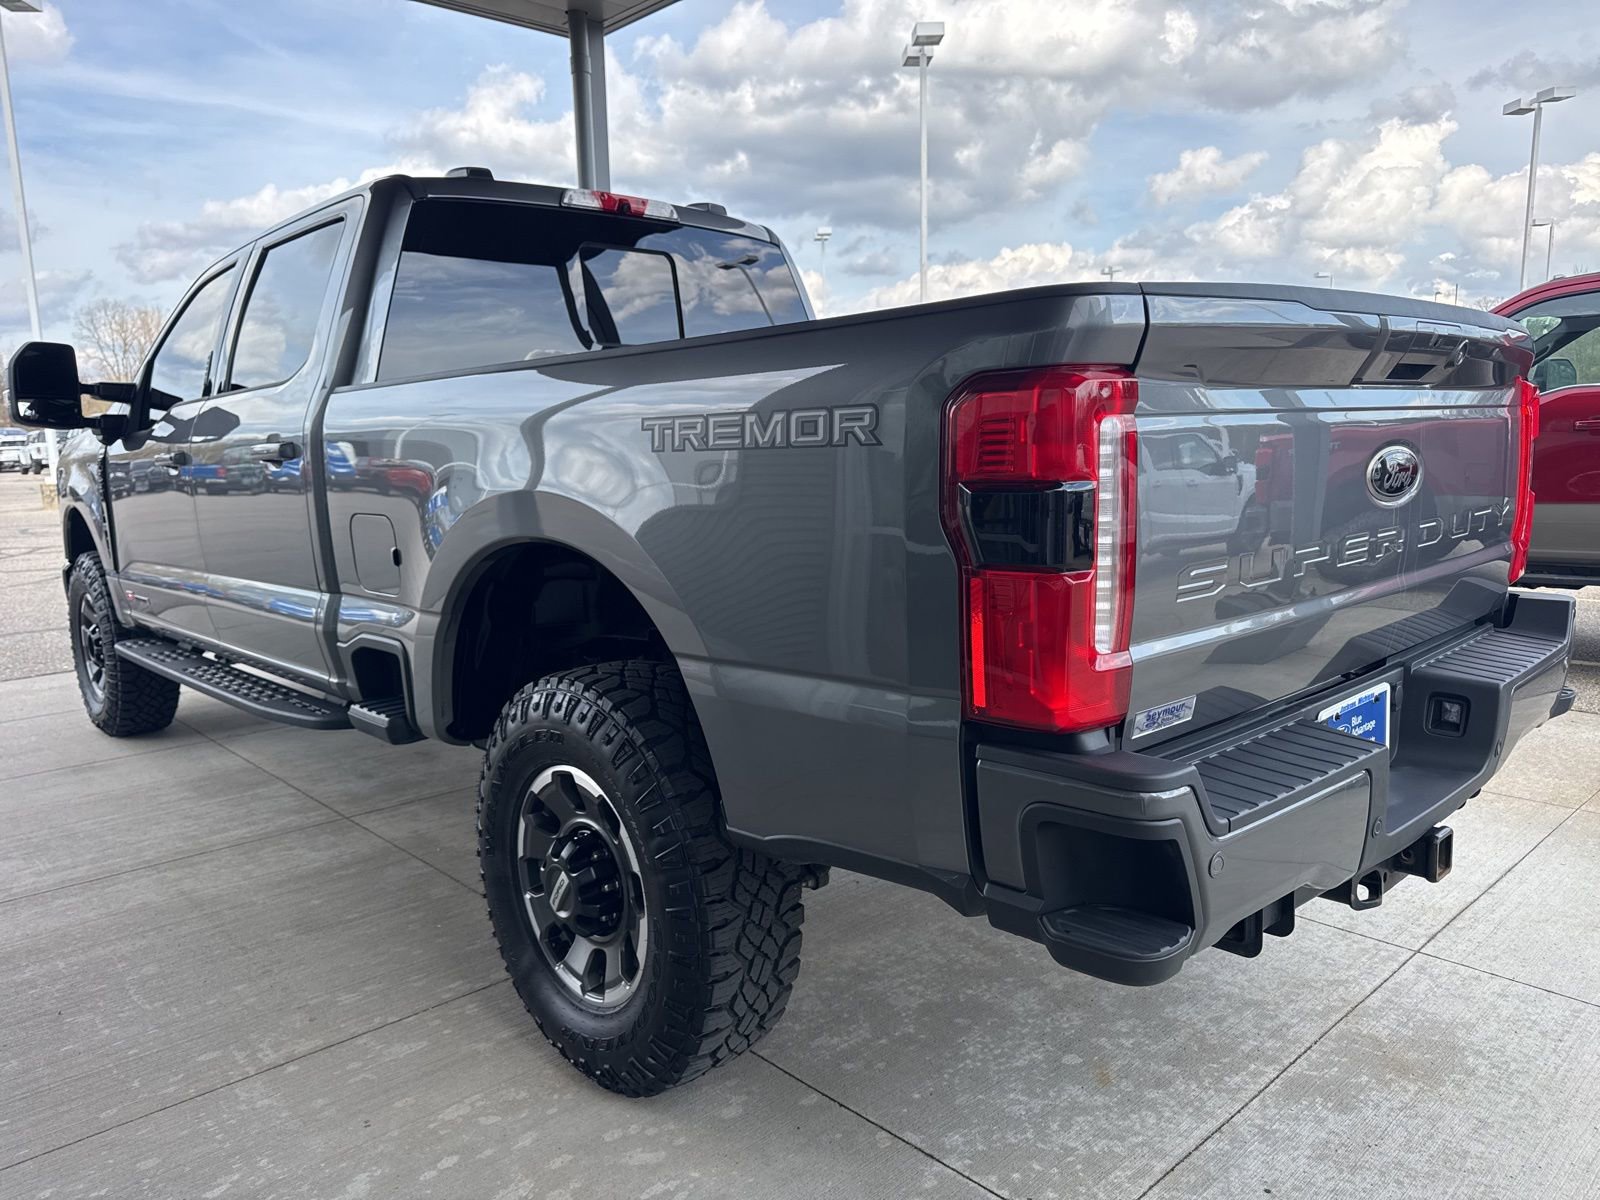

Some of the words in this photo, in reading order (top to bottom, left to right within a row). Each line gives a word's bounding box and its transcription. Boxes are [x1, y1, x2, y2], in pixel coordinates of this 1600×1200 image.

[641, 403, 883, 453] TREMOR
[1384, 463, 1413, 490] Ford
[1175, 526, 1405, 604] SUPER
[1418, 498, 1511, 549] DUTY
[1145, 702, 1186, 723] Seymour
[1351, 715, 1363, 727] Blue
[1352, 720, 1376, 736] Advantage
